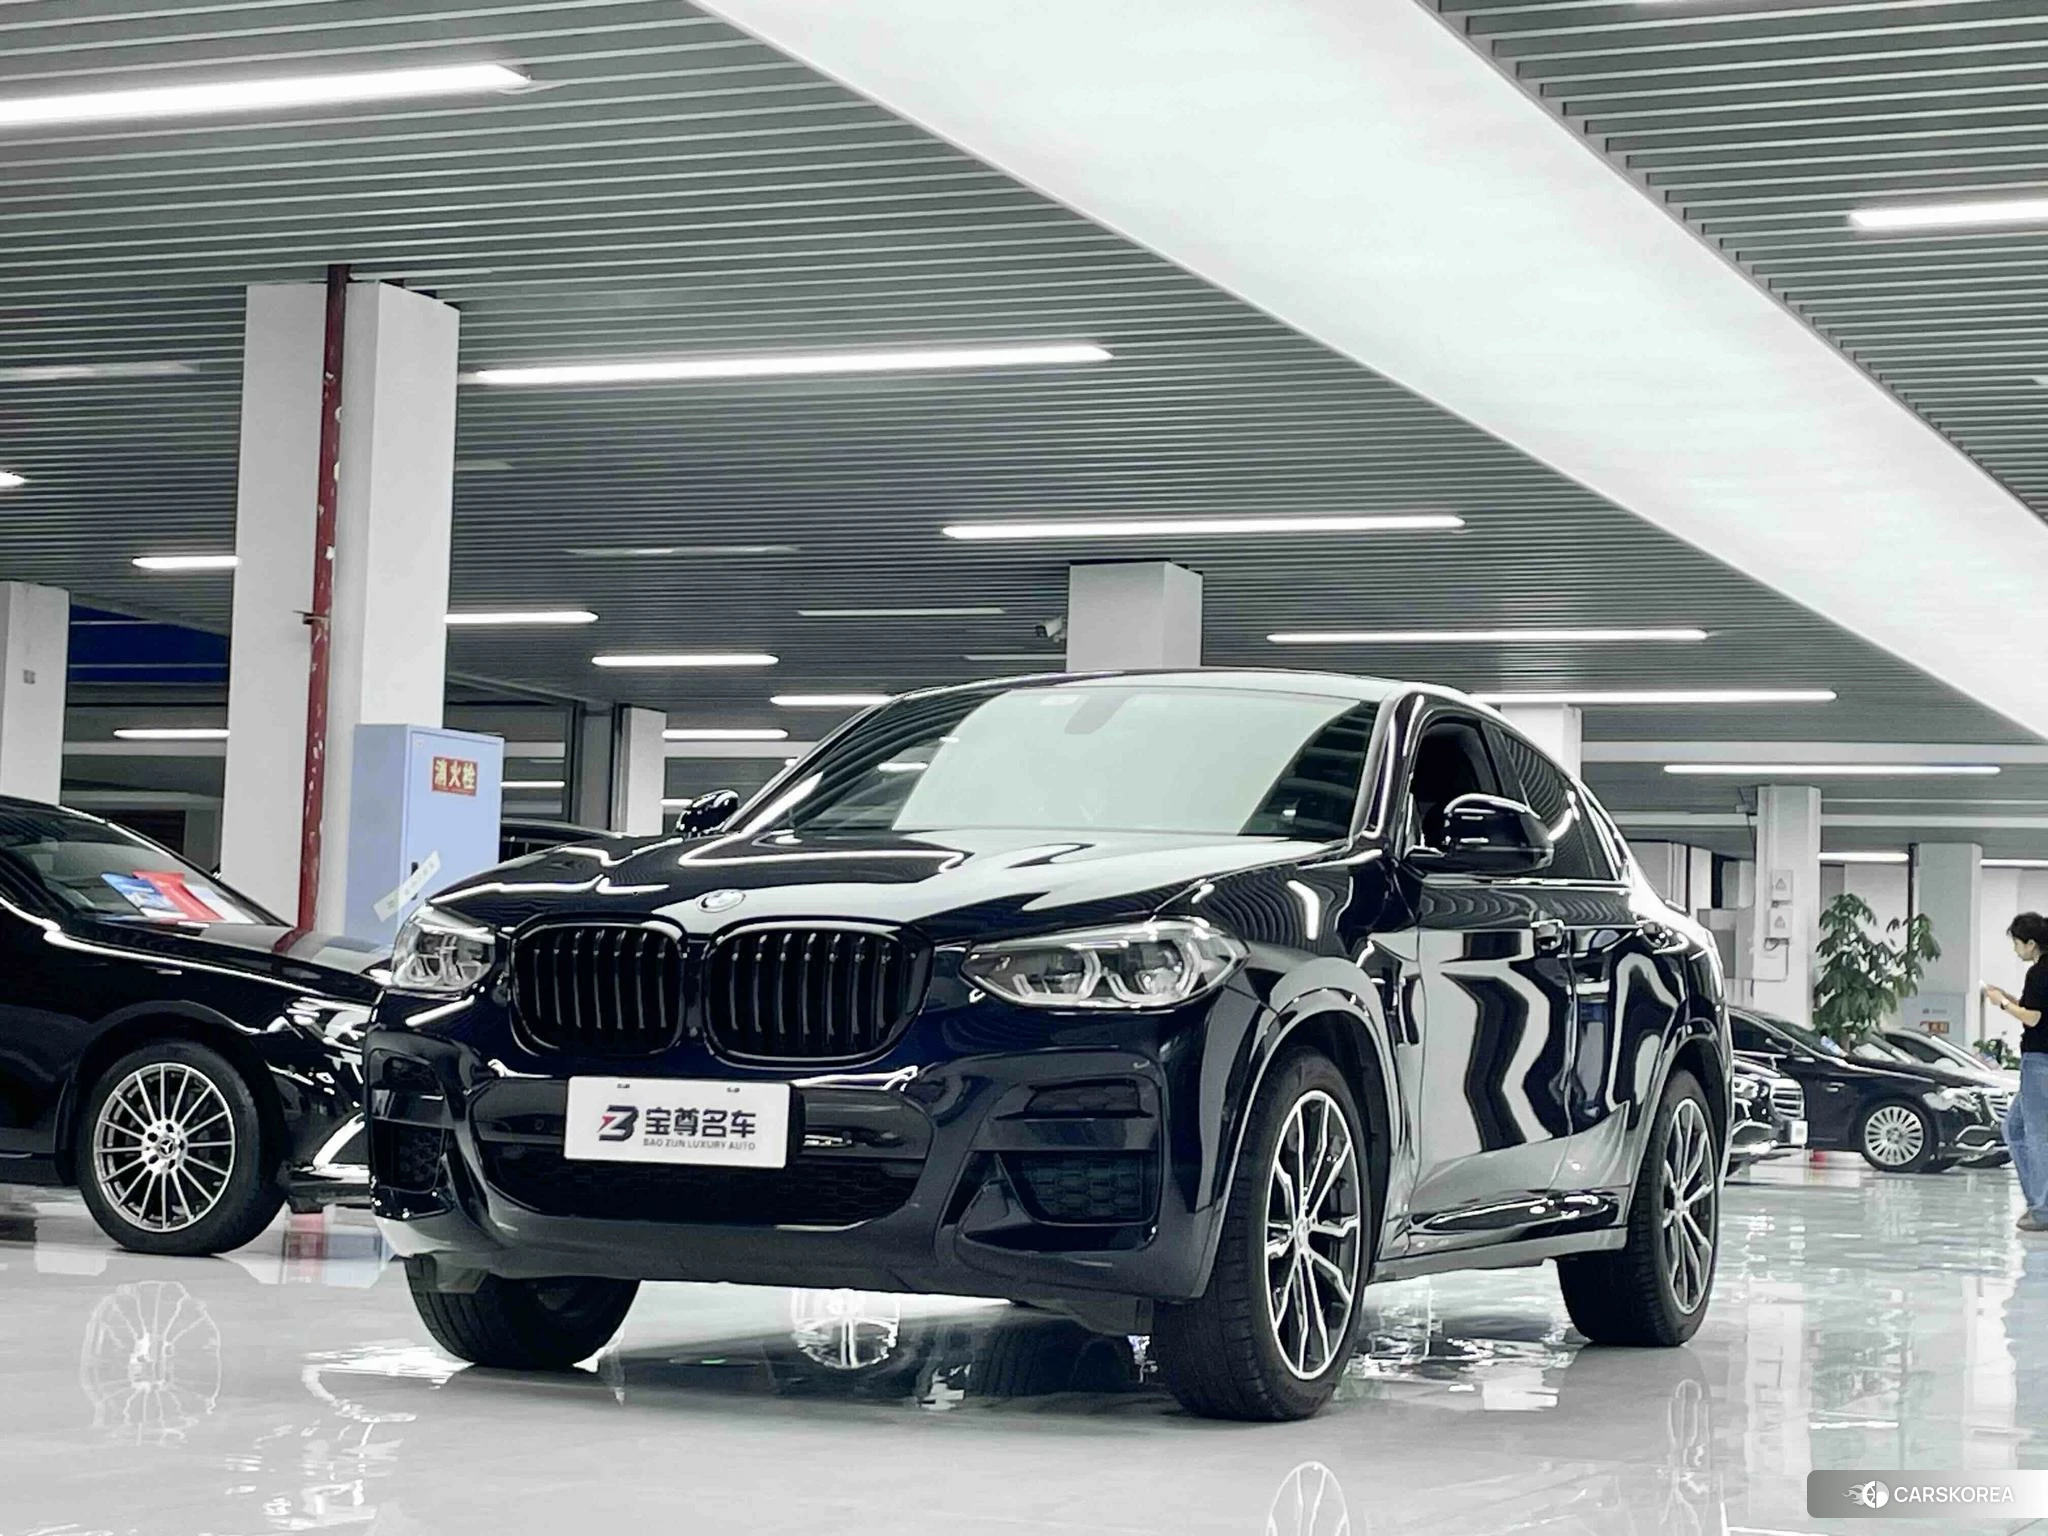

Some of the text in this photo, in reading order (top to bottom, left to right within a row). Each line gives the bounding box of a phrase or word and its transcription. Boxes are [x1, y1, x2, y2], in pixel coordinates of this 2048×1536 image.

[434, 760, 476, 790] 消火栓
[645, 1107, 756, 1138] 宝尊名车
[643, 1138, 756, 1150] BAO ZUN LUXURY AUTO
